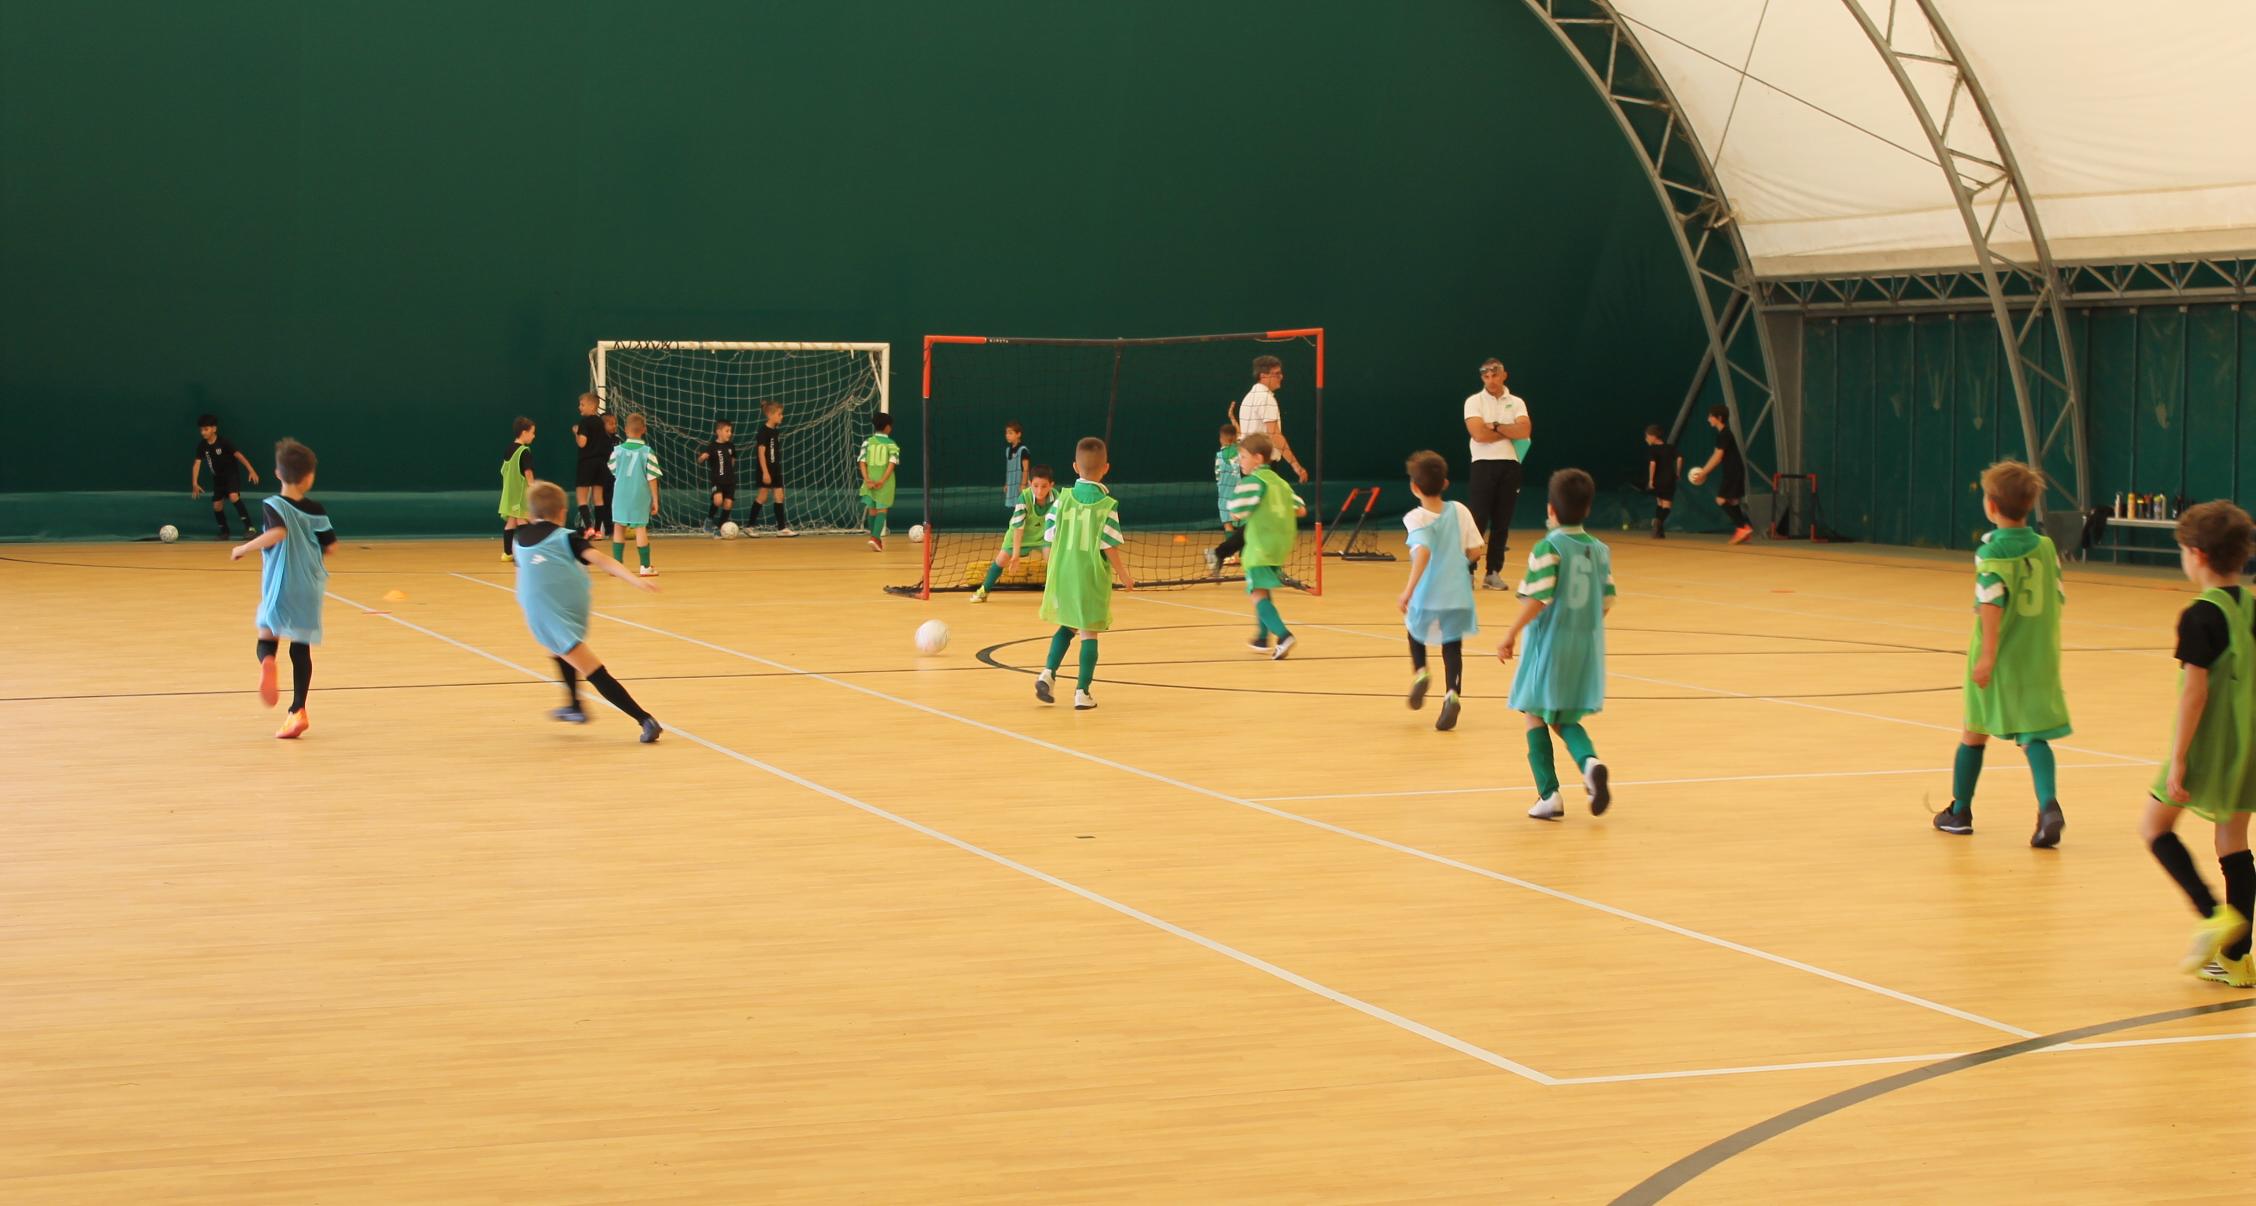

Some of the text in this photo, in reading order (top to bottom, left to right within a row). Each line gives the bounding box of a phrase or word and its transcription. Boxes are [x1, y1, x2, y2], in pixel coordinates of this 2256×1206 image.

[626, 451, 640, 476] 7
[868, 444, 887, 466] 10
[1062, 507, 1092, 552] 11
[1568, 553, 1593, 609] 6
[2016, 556, 2044, 618] 3
